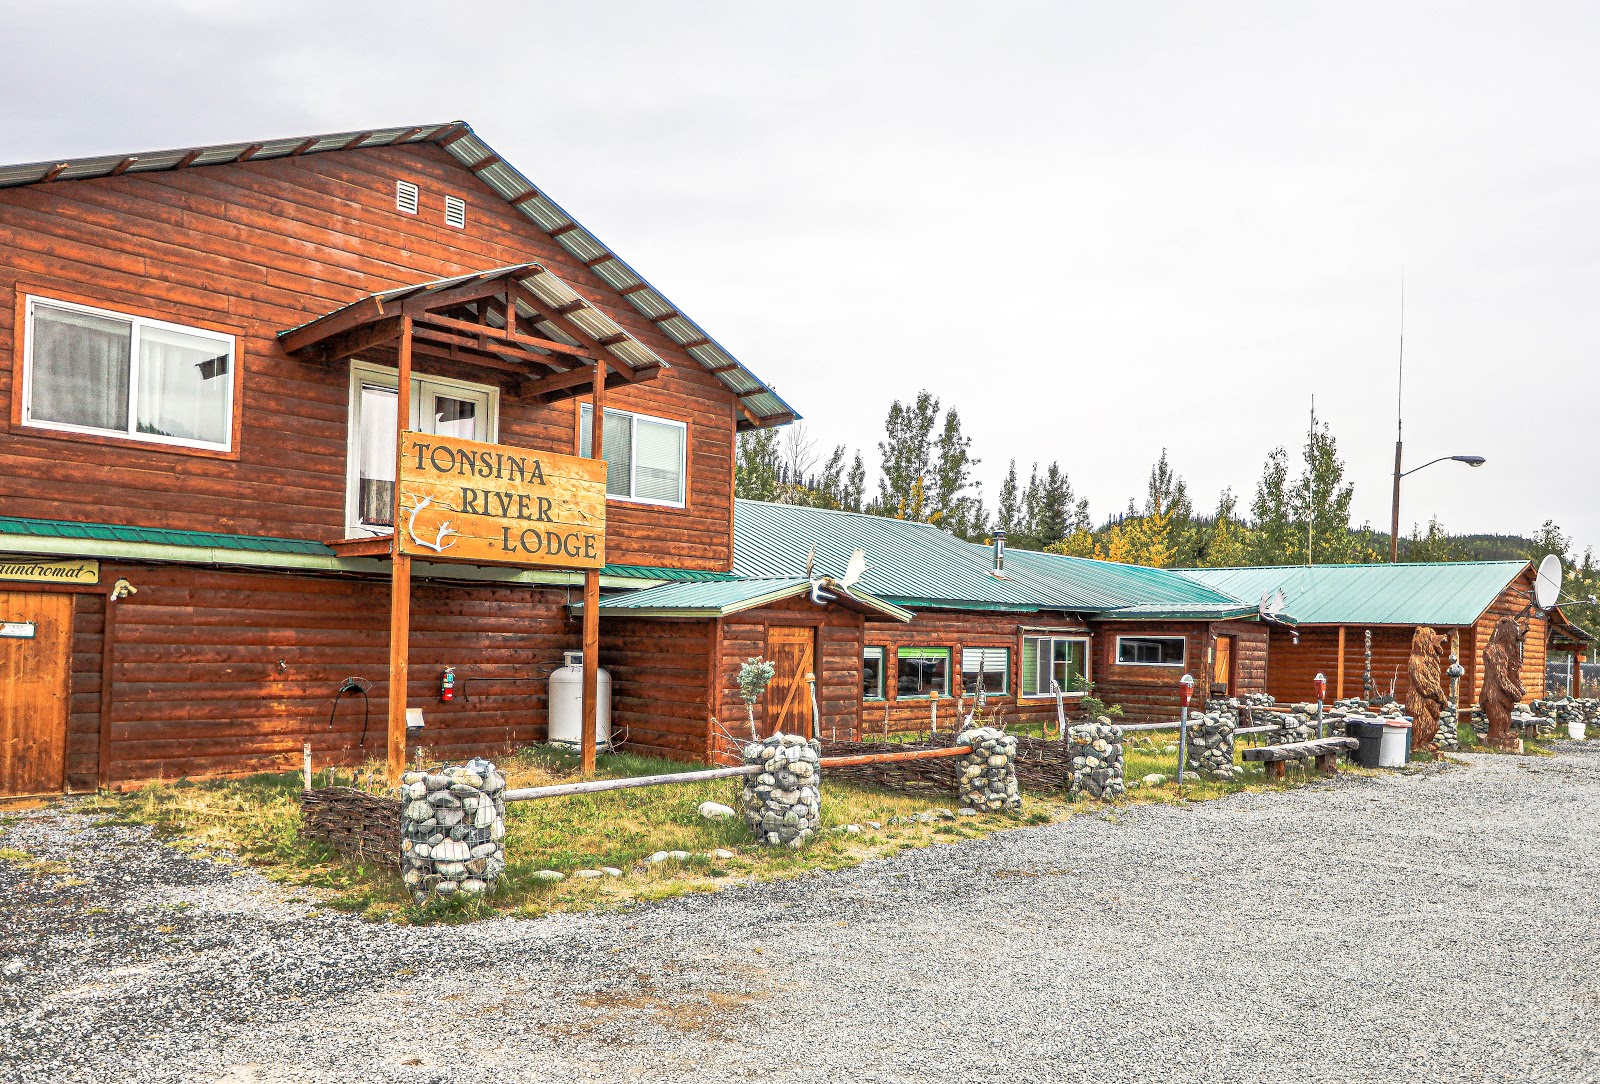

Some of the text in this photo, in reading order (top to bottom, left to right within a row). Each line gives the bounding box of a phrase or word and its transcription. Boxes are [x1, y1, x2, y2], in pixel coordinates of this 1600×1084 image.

[412, 441, 547, 486] TONSINA
[460, 487, 554, 523] RIVER
[501, 526, 597, 560] LODGE
